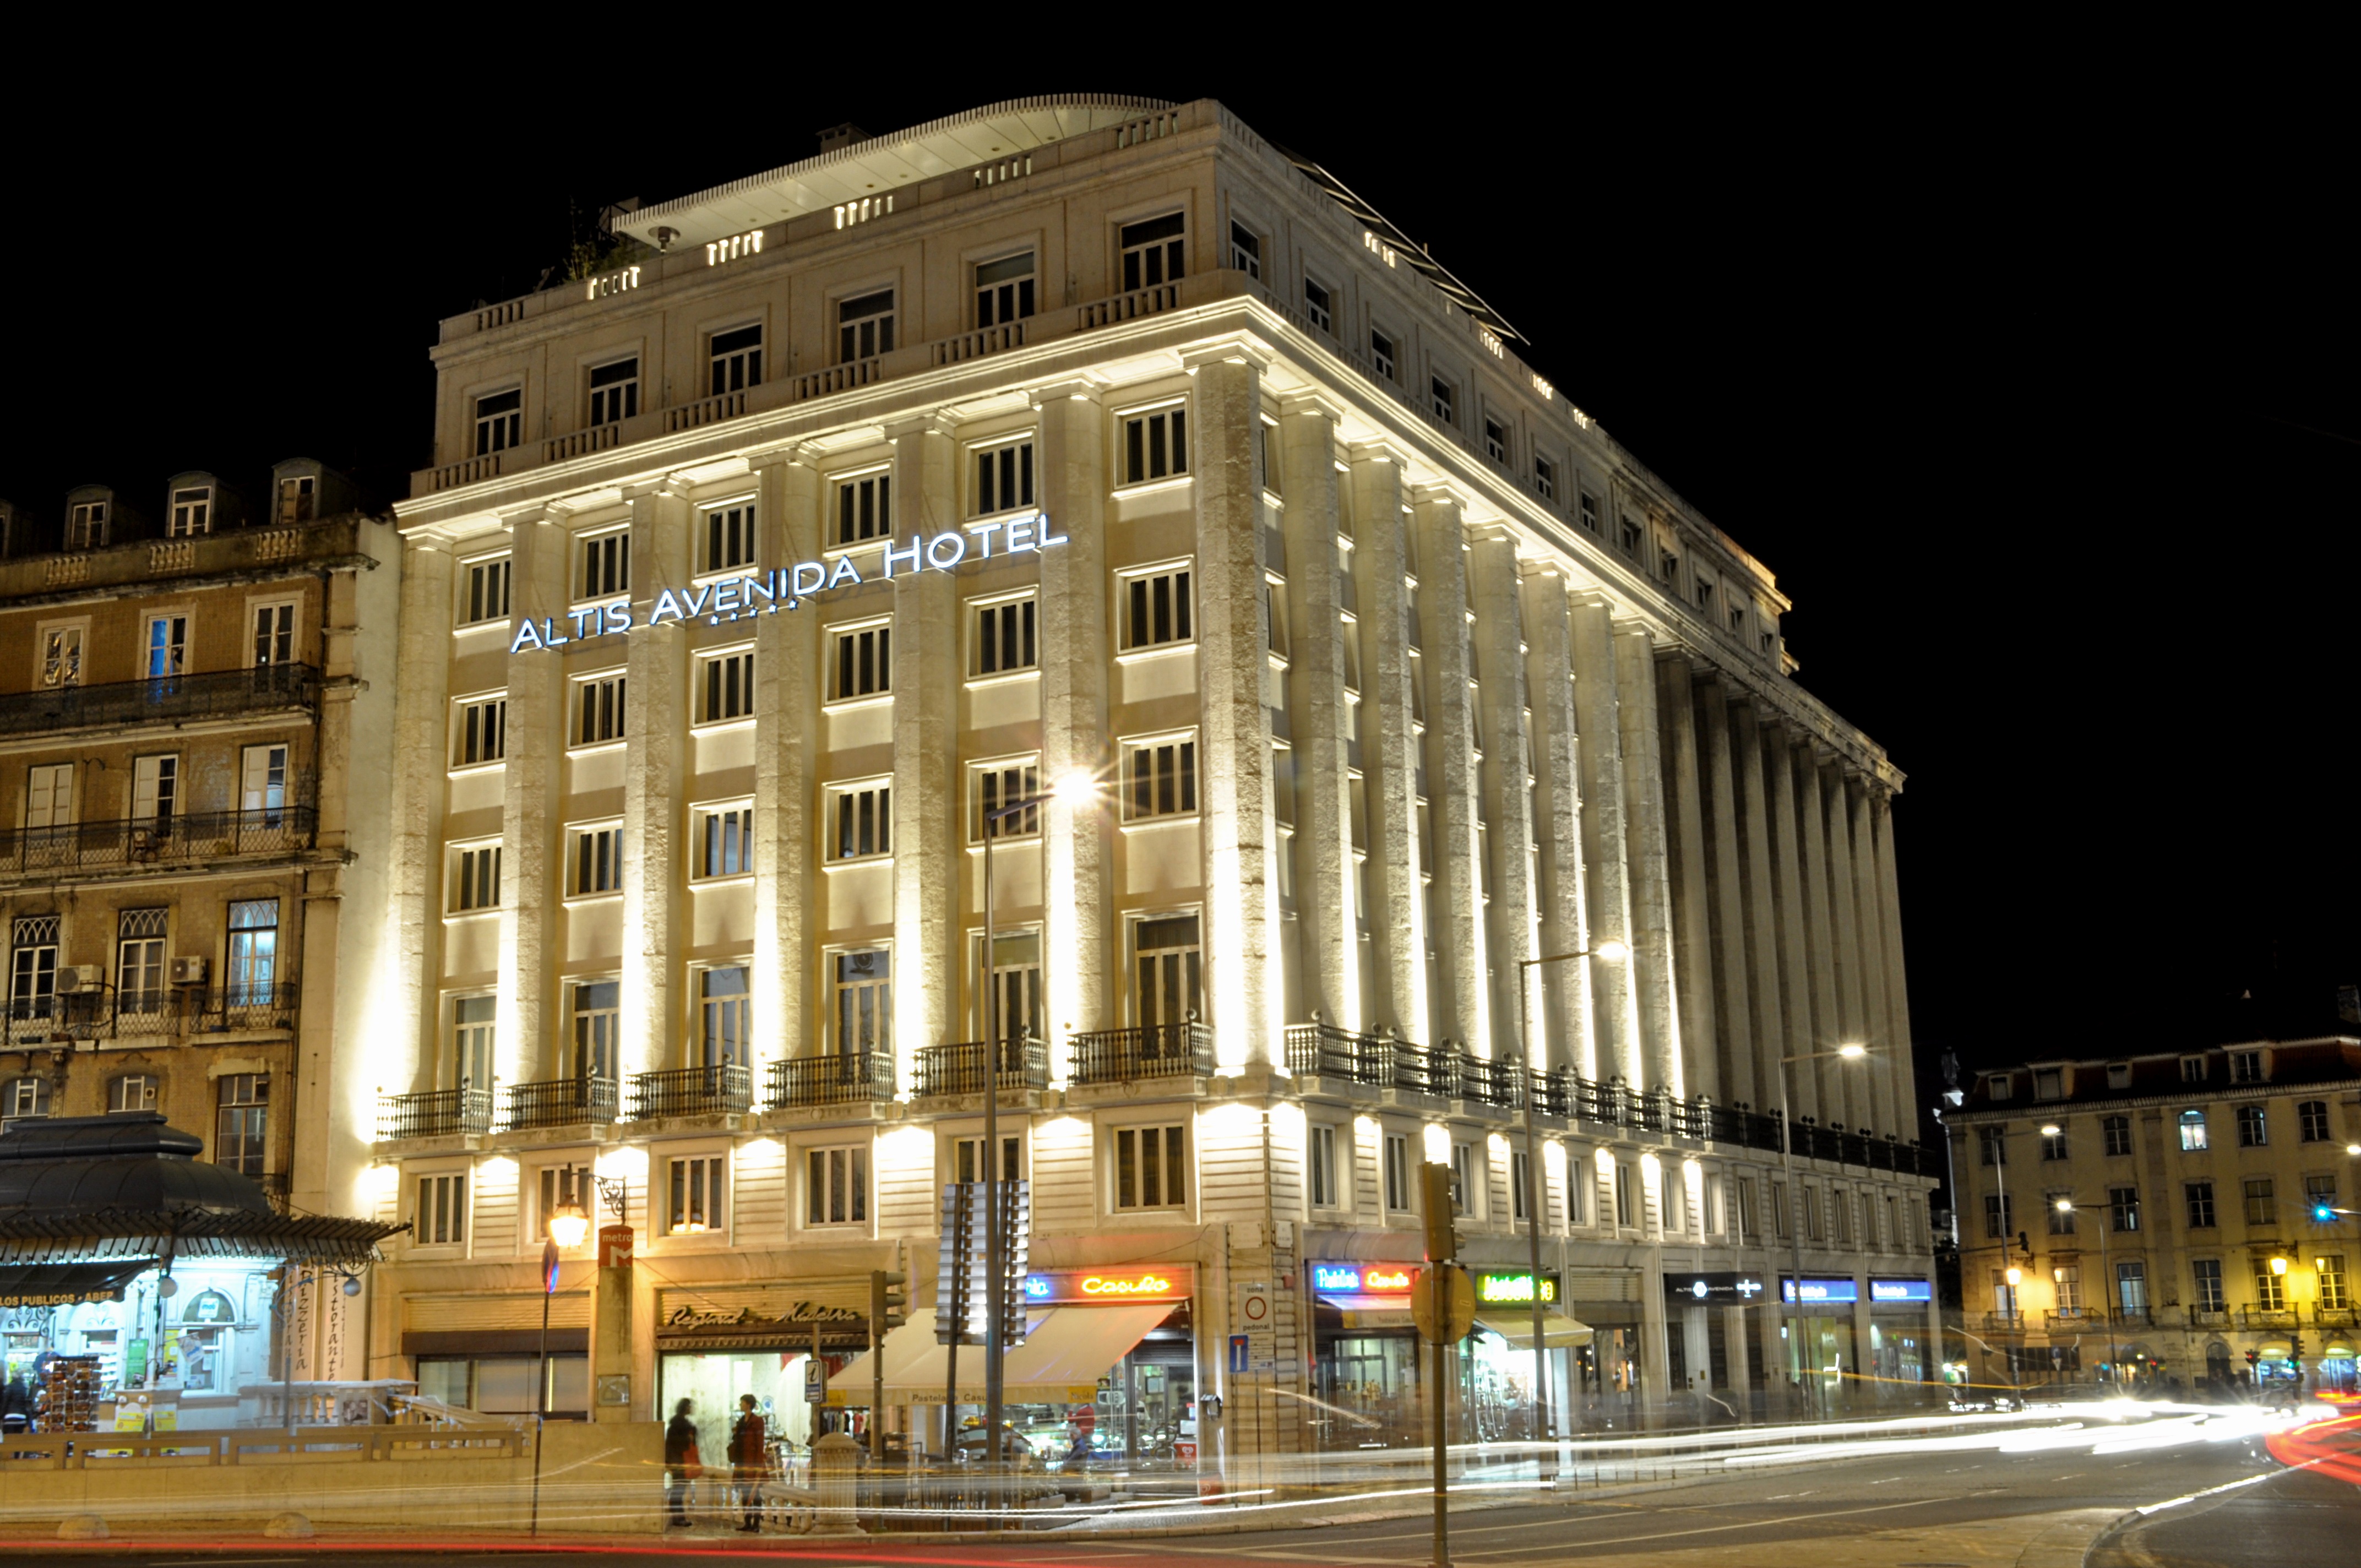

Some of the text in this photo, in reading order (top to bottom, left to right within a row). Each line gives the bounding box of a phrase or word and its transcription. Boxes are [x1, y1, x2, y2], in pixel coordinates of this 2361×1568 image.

[510, 513, 1070, 654] ALTIS AVENIDA HOTEL
[602, 1233, 633, 1243] metro
[1081, 1276, 1171, 1294] Casulo
[22, 1294, 75, 1305] PUBLICOS
[964, 1393, 987, 1402] Casu
